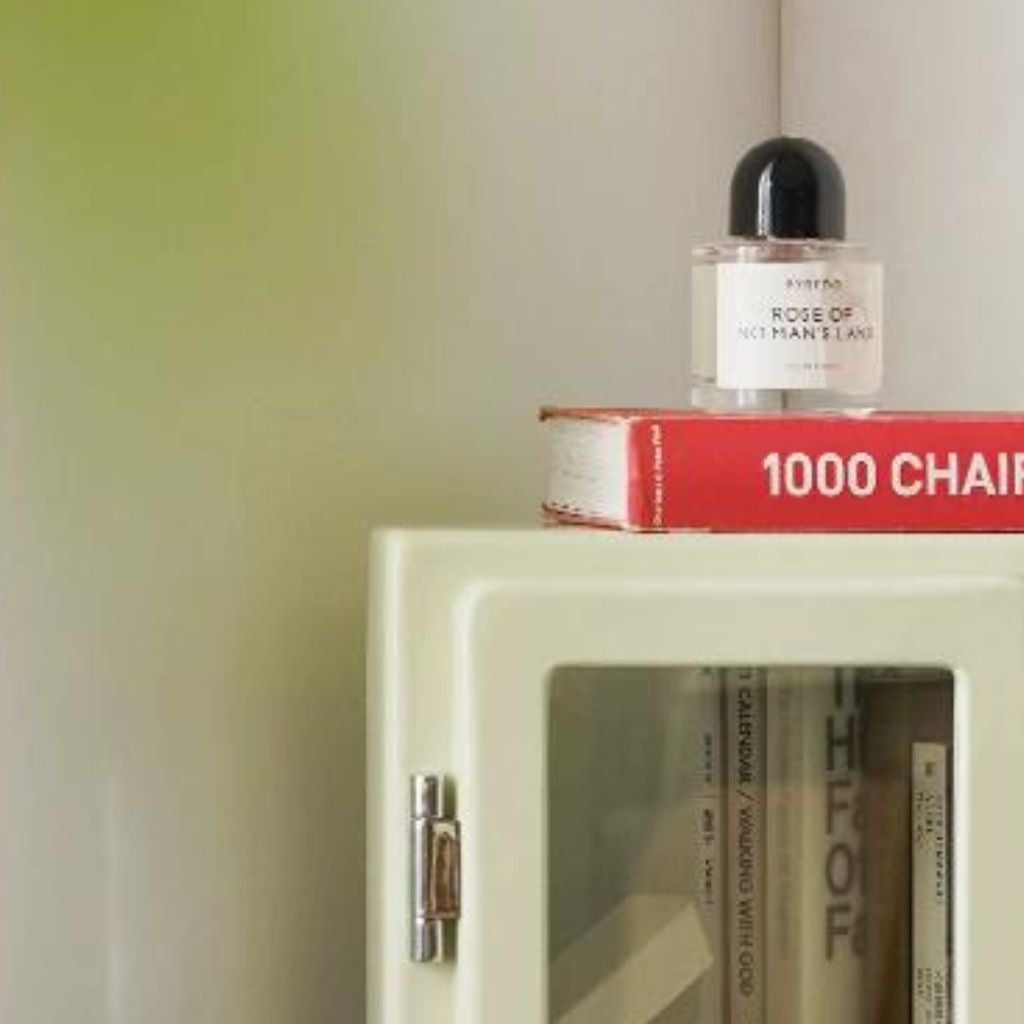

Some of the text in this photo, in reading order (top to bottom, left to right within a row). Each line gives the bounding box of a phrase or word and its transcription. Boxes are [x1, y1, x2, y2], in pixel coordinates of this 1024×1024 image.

[771, 306, 853, 323] ROSE OF
[771, 326, 830, 341] MAN'S
[763, 452, 876, 496] 1000
[738, 687, 754, 784] CALENDAR
[738, 806, 754, 894] WALKING
[738, 898, 754, 948] WITH
